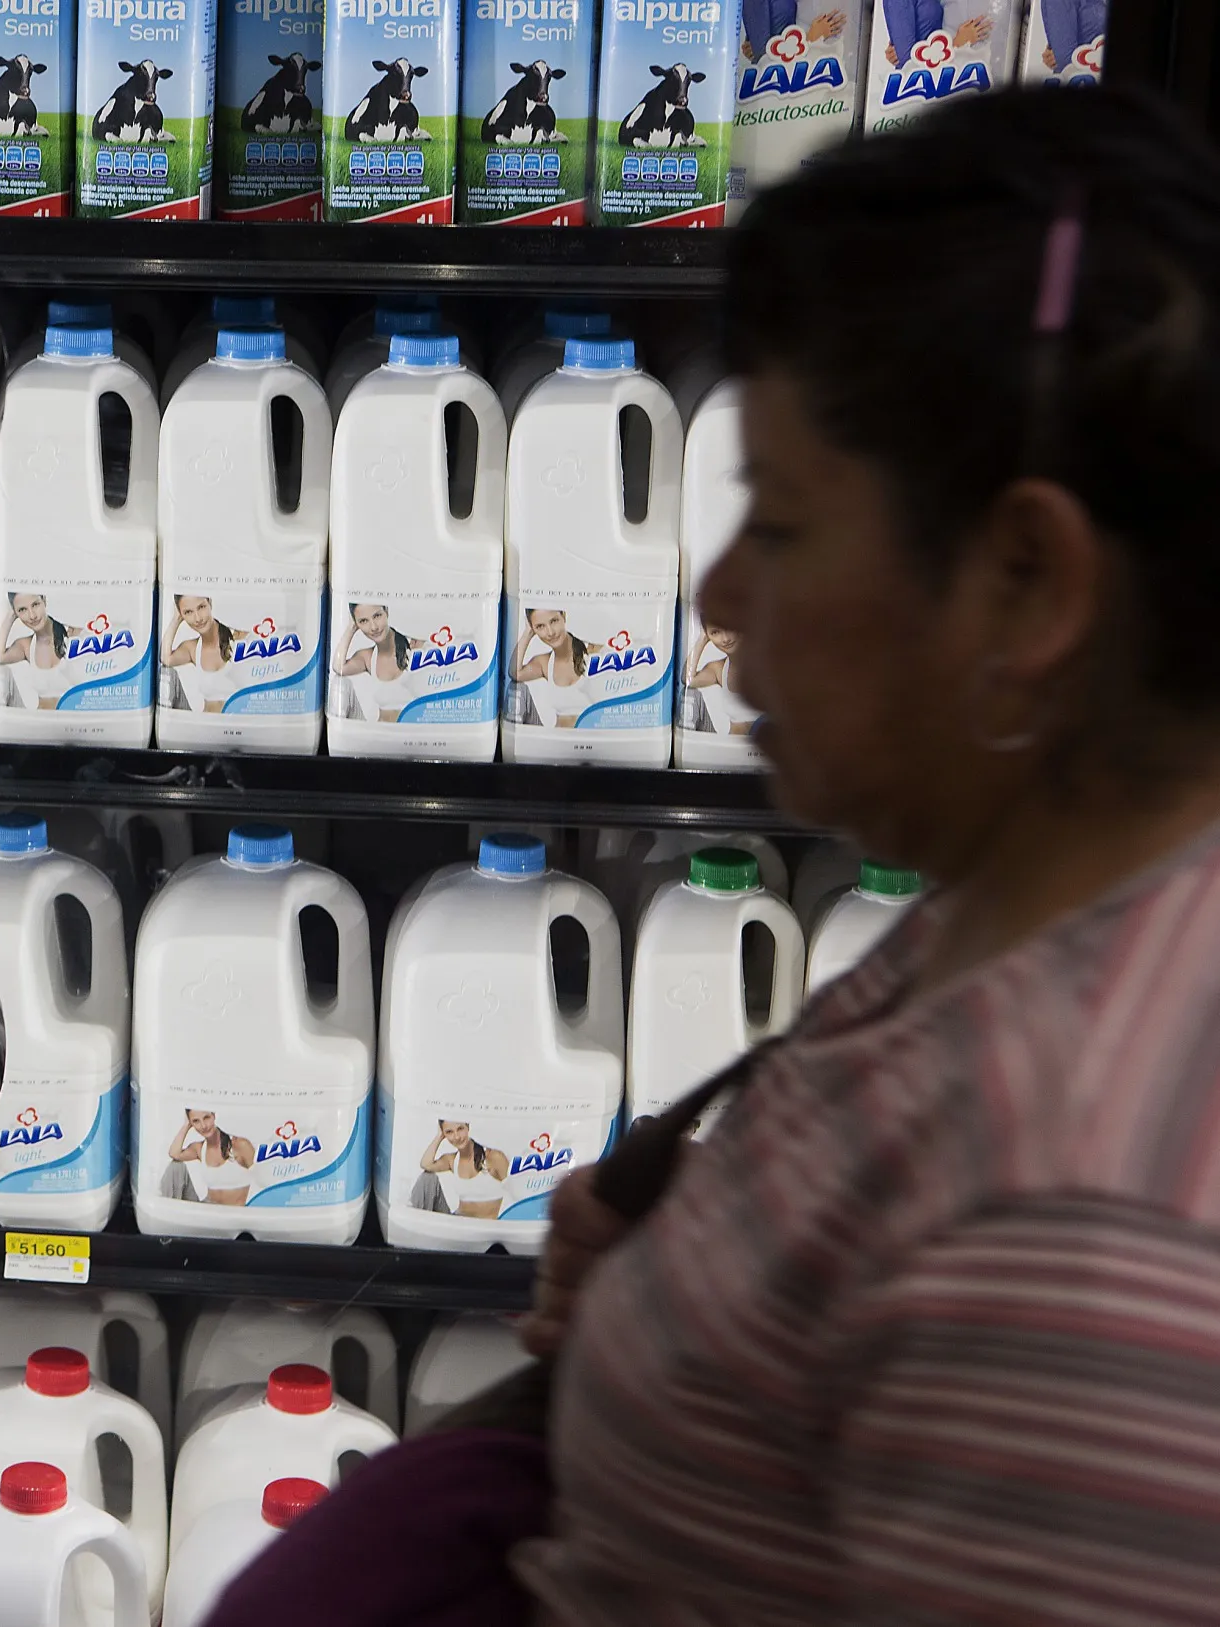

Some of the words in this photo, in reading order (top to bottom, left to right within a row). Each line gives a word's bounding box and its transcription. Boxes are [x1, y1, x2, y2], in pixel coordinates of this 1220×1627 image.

[86, 0, 185, 27] alpura
[339, 0, 440, 24] alpura
[476, 0, 578, 28] alpura
[616, 0, 721, 29] alpura
[5, 18, 54, 36] Semi
[129, 24, 179, 42] Semi
[279, 18, 322, 35] Sem
[383, 20, 434, 38] Semi
[522, 22, 574, 41] Semi
[662, 25, 712, 44] Semi
[739, 58, 844, 100] LALA
[883, 62, 991, 105] LALA
[733, 98, 843, 127] deslactosada
[69, 632, 134, 658] LALA
[235, 635, 300, 662] LALA
[84, 659, 113, 675] light
[411, 644, 477, 670] LALA
[588, 648, 655, 676] LALA
[251, 663, 280, 677] light
[427, 672, 457, 687] light
[604, 675, 635, 693] light
[0, 1124, 62, 1147] LALA
[14, 1148, 43, 1163] light
[257, 1136, 320, 1162] LALA
[272, 1163, 301, 1178] light
[511, 1149, 573, 1174] LALA
[527, 1175, 555, 1191] light
[20, 1243, 66, 1257] 51.60
